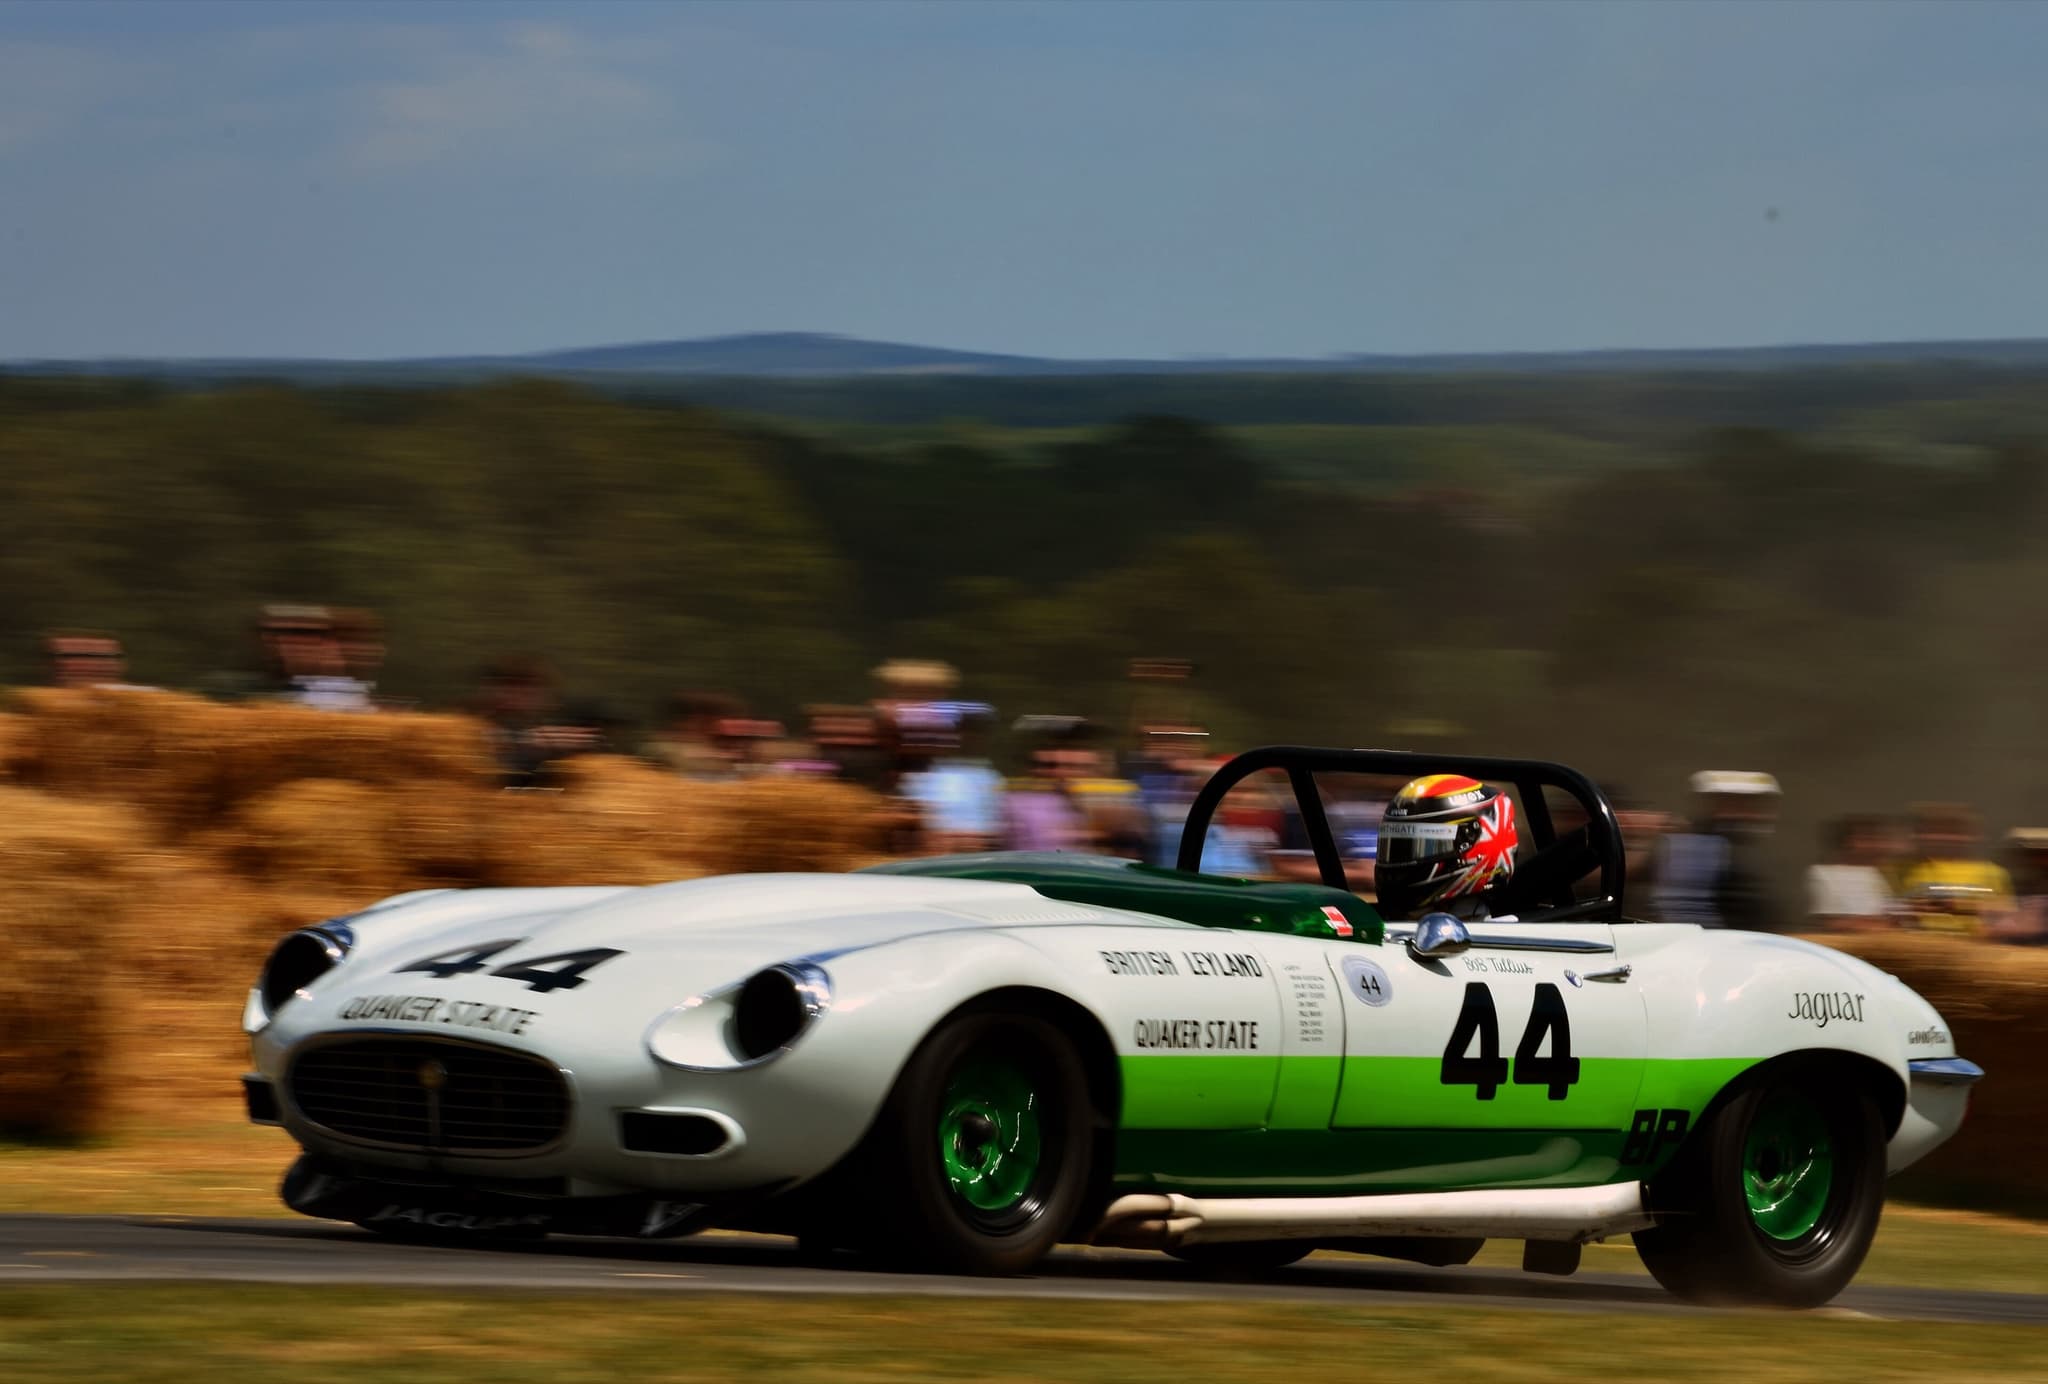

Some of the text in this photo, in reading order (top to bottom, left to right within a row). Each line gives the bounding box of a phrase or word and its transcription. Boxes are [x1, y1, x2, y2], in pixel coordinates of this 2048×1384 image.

[394, 936, 626, 993] 44
[1101, 951, 1264, 977] BRITISH LEYLAND
[1361, 975, 1381, 995] 44
[340, 997, 542, 1036] QUAKER STATE
[1134, 1020, 1258, 1049] QUAKER STATE
[1440, 982, 1580, 1101] 44
[1619, 1109, 1691, 1165] BP
